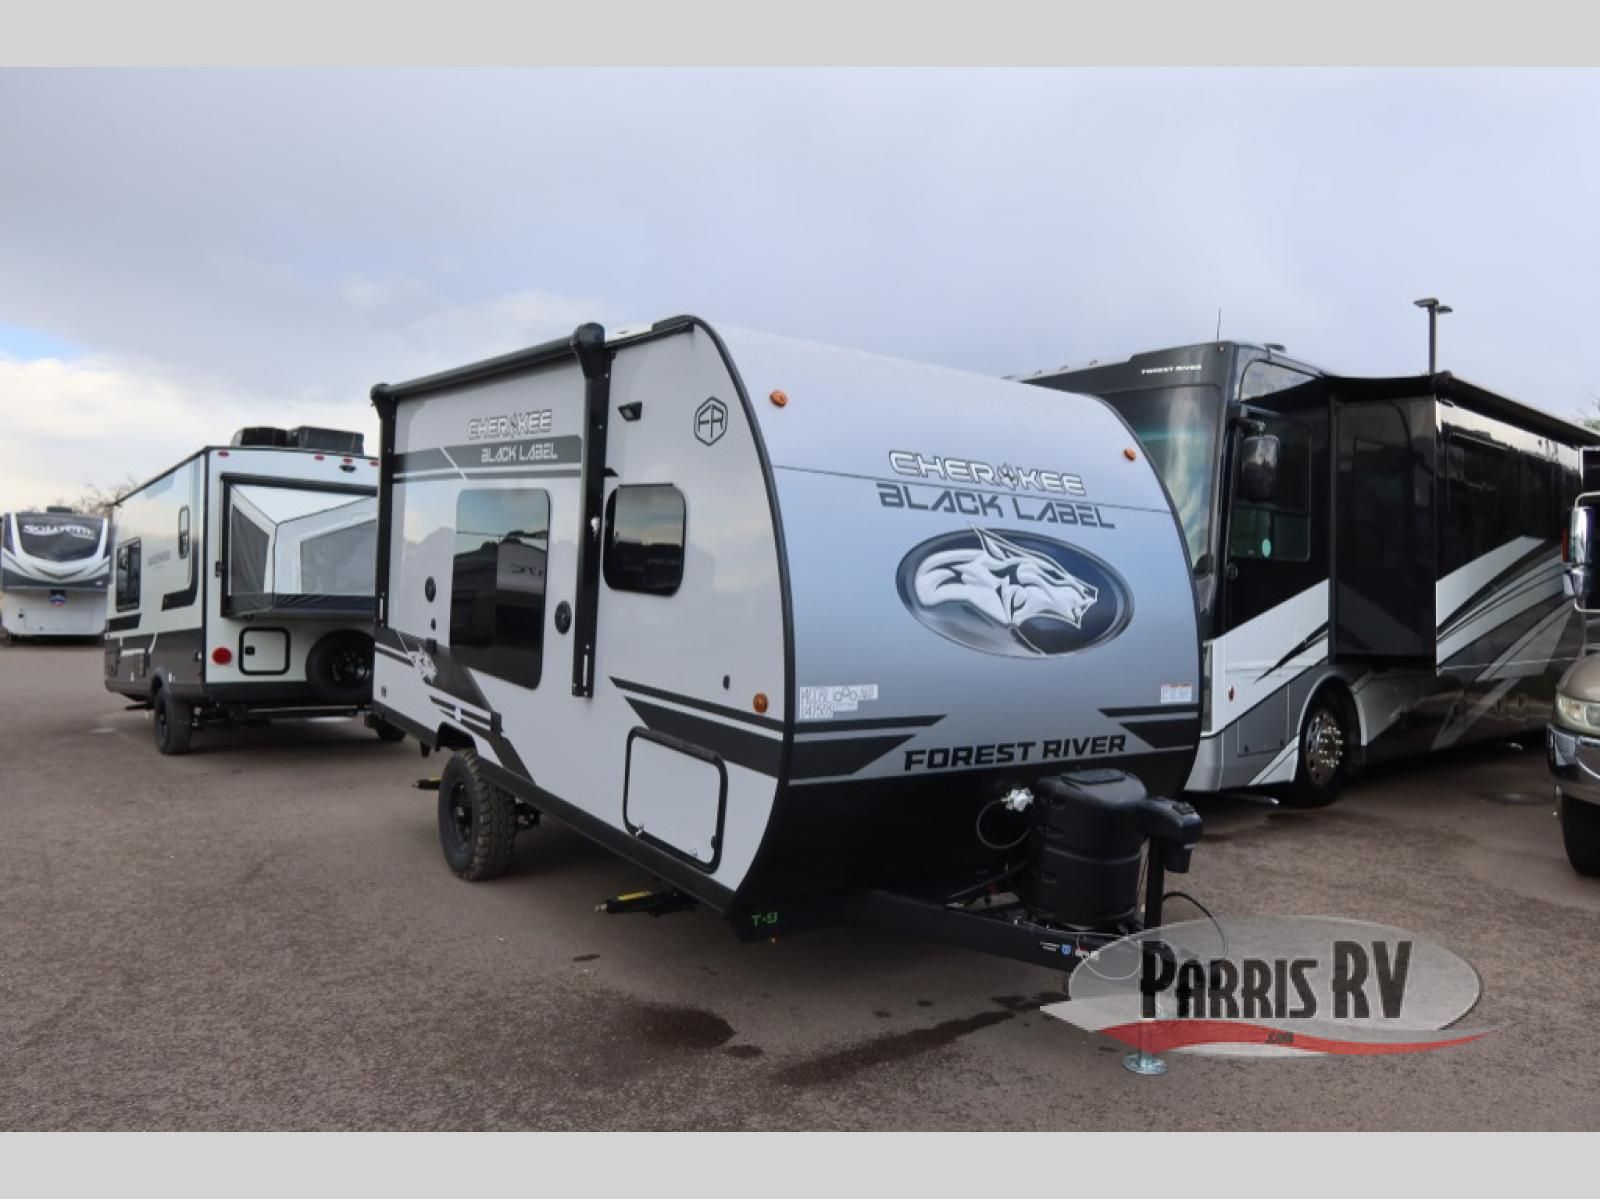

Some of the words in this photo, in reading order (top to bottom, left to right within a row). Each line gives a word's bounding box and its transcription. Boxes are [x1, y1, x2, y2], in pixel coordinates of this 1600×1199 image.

[480, 445, 517, 463] BLACK
[519, 441, 559, 461] LABEL
[876, 482, 1004, 518] BLACK
[1012, 497, 1116, 529] LABEL
[904, 741, 1037, 771] FOREST
[1041, 734, 1127, 759] RIVER
